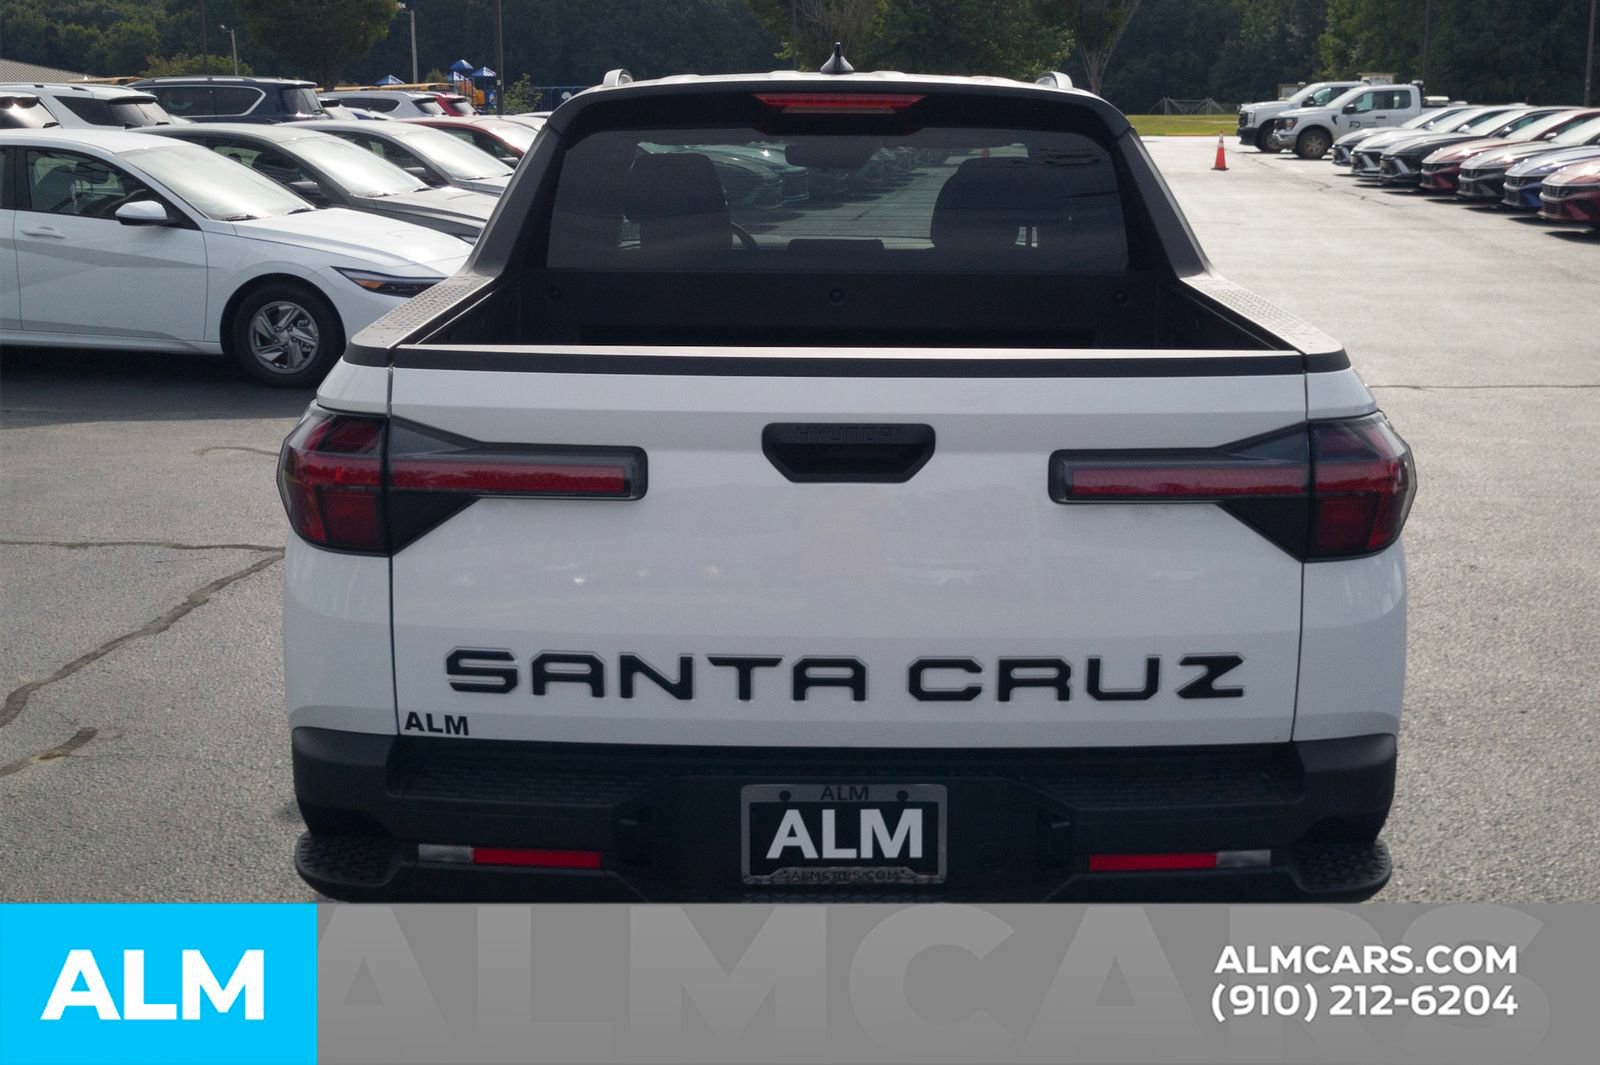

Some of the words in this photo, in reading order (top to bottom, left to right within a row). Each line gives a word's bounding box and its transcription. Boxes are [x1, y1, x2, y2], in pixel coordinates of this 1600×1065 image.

[445, 648, 868, 702] SANTA
[907, 653, 1245, 702] CRUZ
[404, 711, 469, 736] ALM
[820, 785, 870, 802] ALM
[766, 808, 923, 859] ALM
